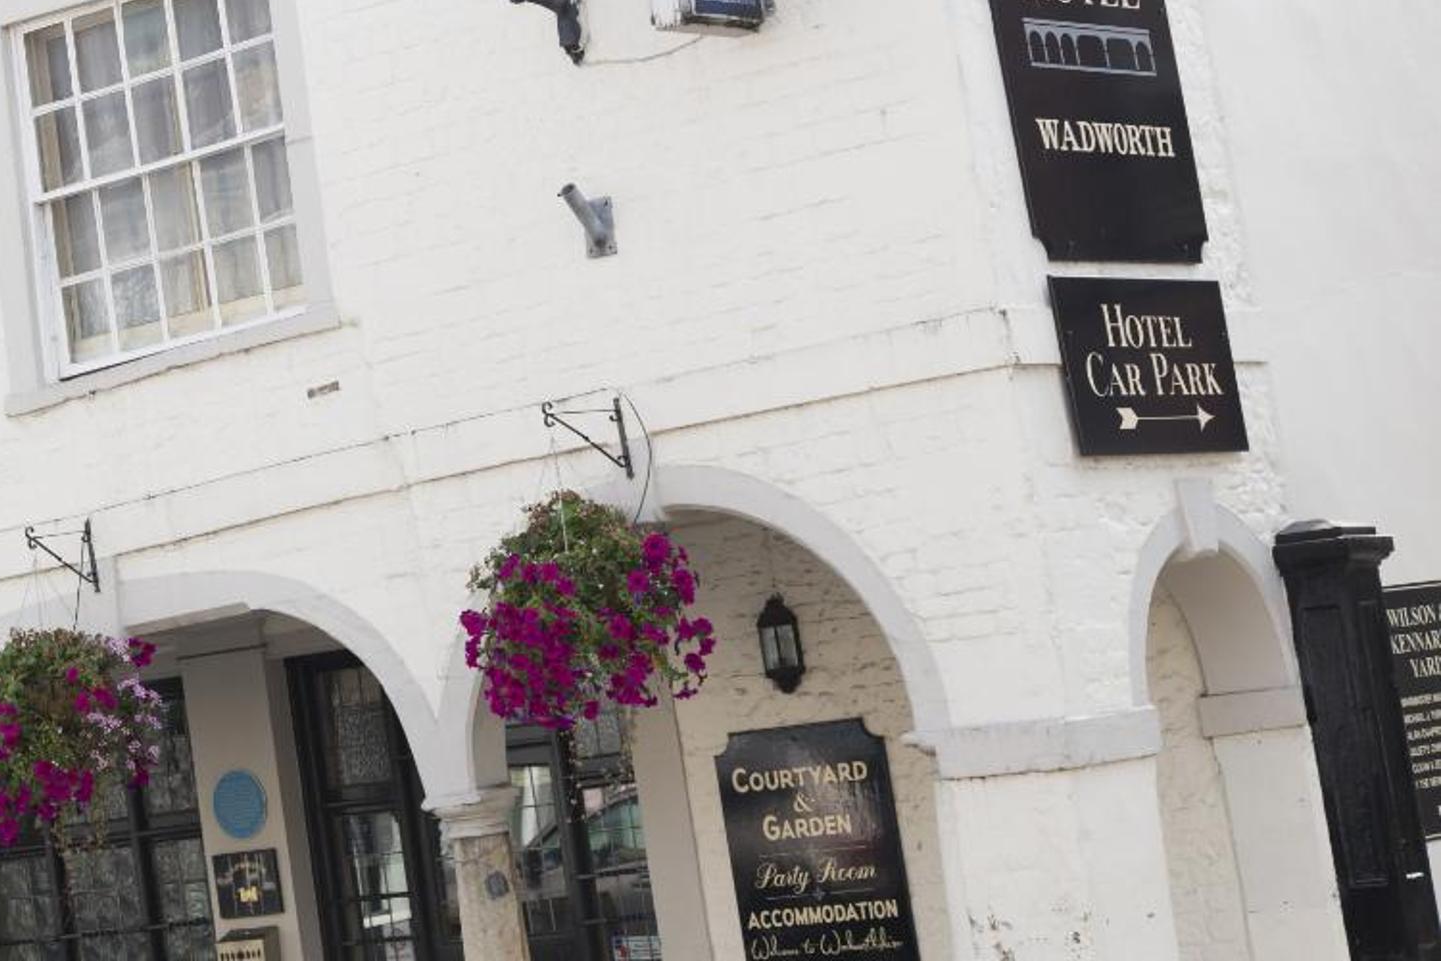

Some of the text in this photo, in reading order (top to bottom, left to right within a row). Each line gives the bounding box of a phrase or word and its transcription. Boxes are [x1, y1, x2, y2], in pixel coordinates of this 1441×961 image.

[1035, 118, 1175, 158] WADWORTH
[1386, 604, 1436, 627] WILSON
[731, 760, 868, 794] COURTYARD
[793, 791, 814, 813] &
[762, 814, 852, 841] GARDEN
[755, 857, 877, 893] Party Room
[748, 899, 899, 930] ACCOMMODATION
